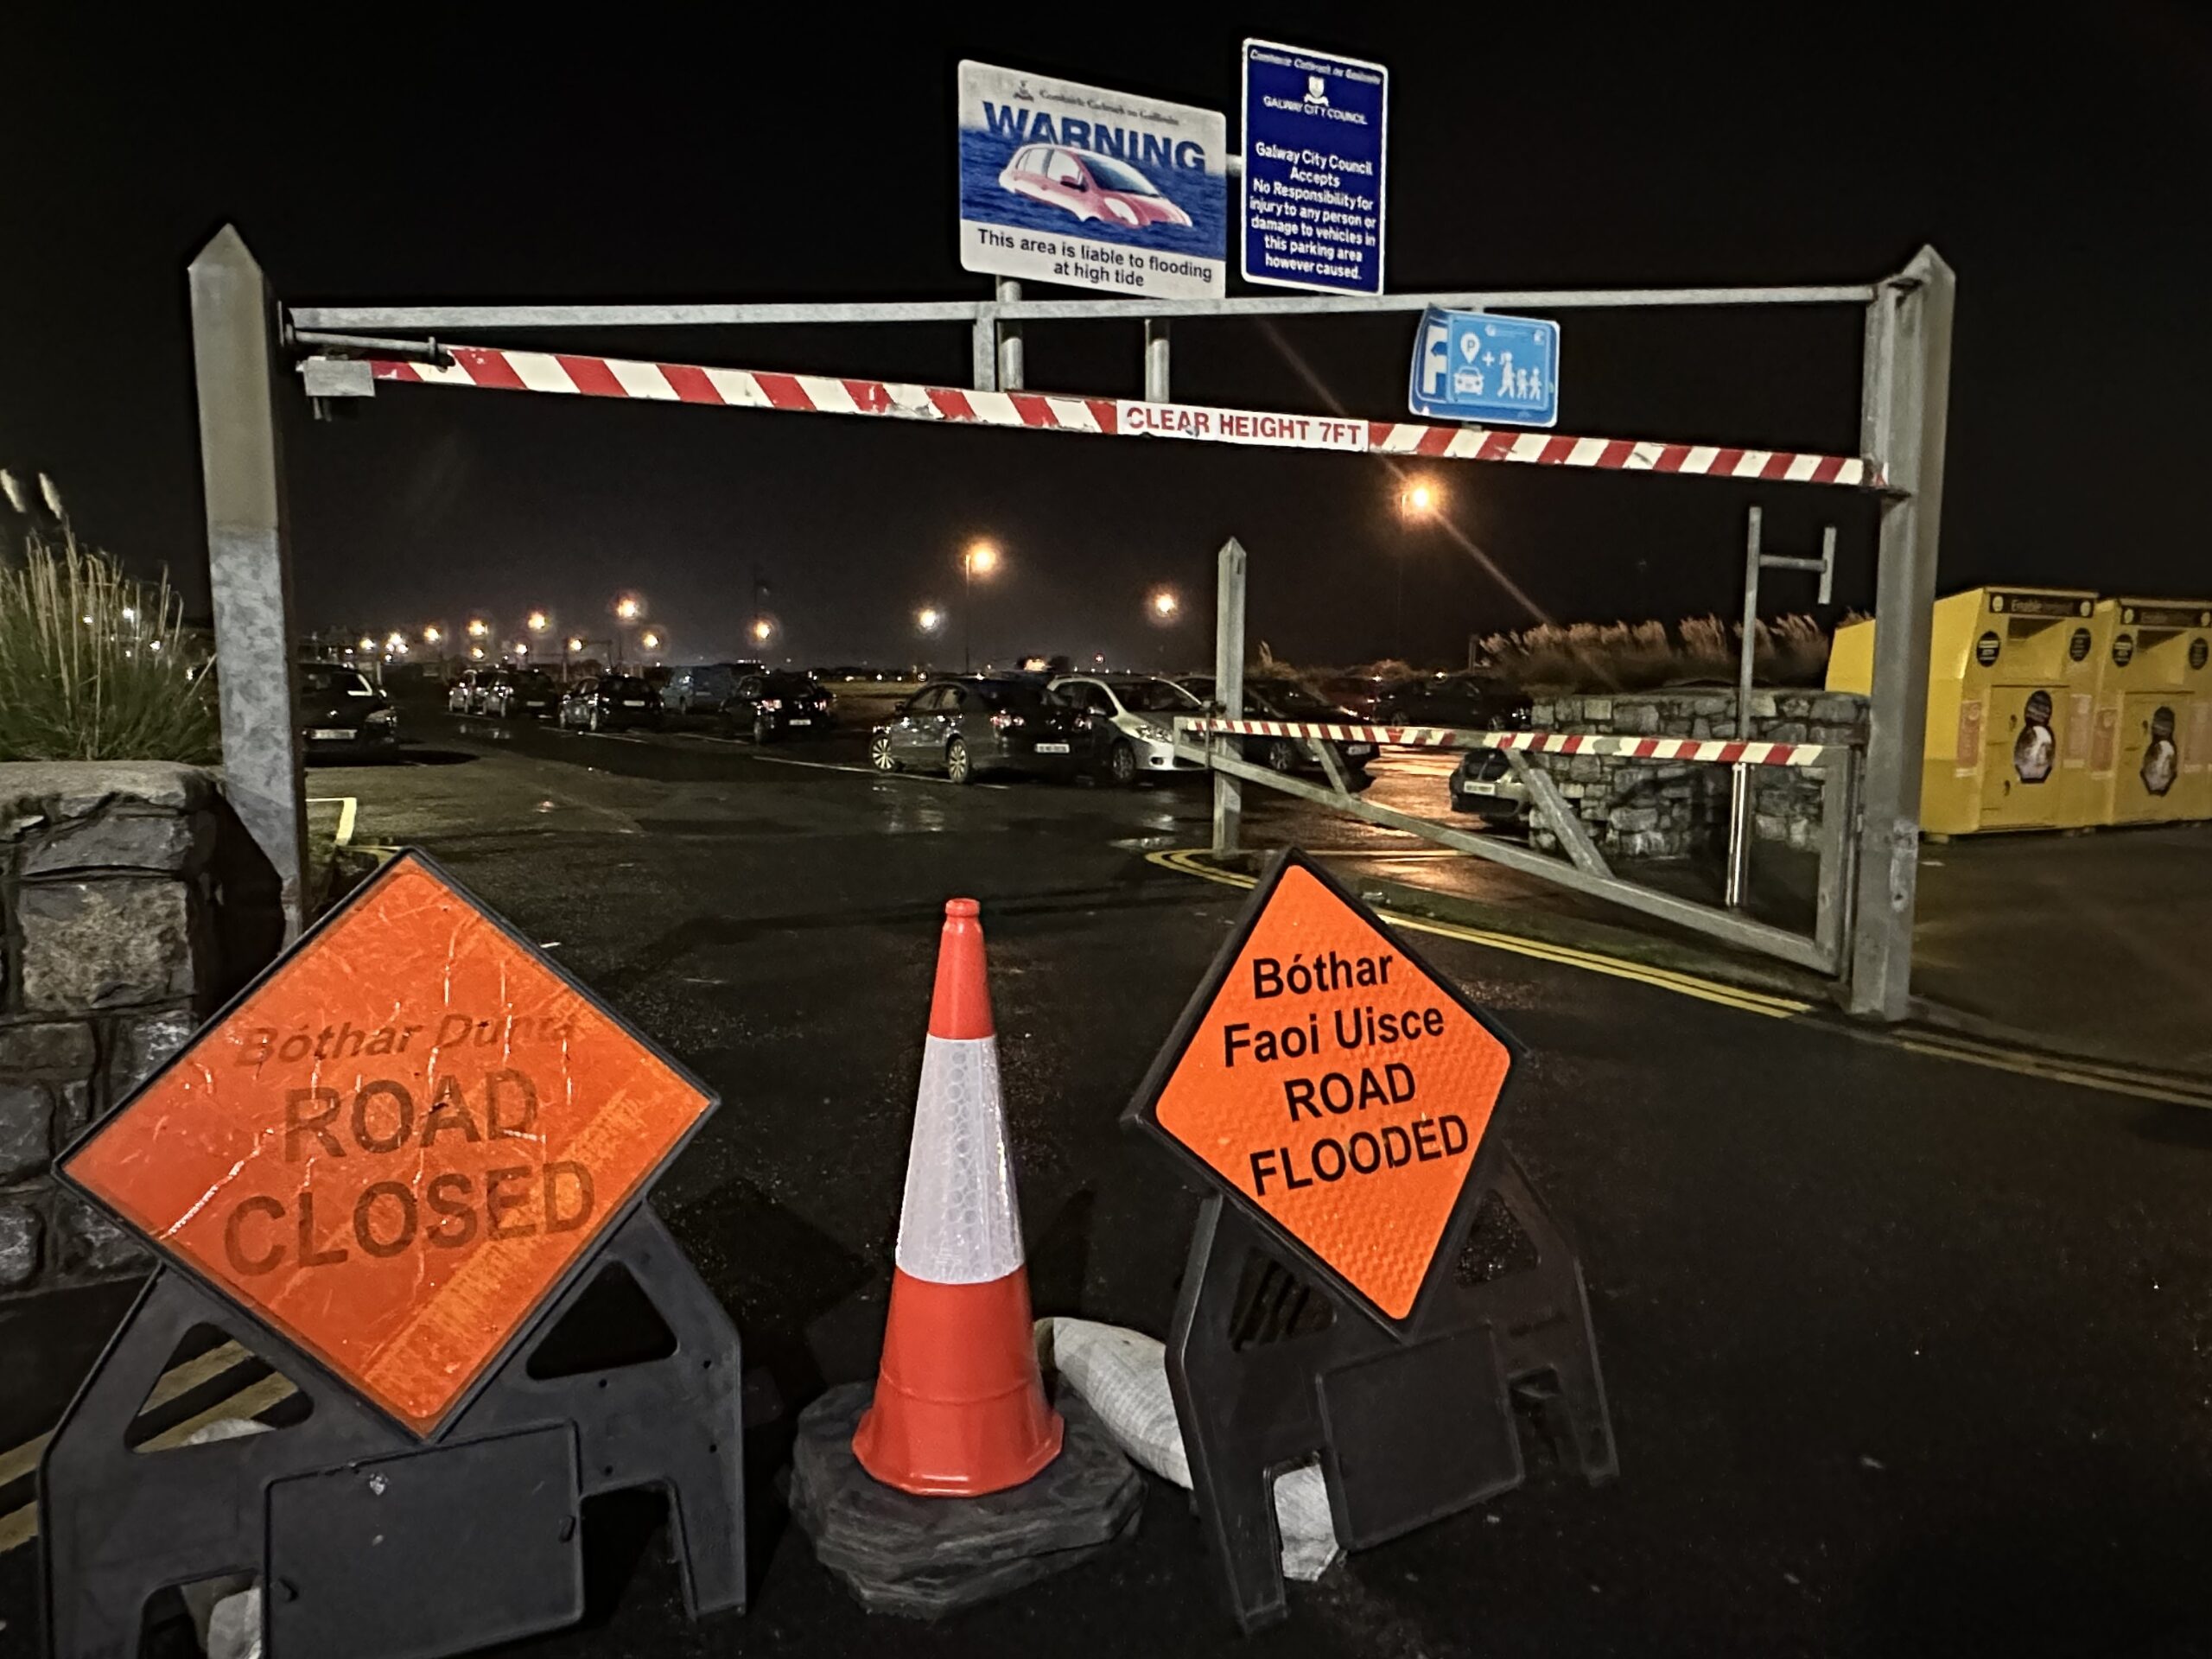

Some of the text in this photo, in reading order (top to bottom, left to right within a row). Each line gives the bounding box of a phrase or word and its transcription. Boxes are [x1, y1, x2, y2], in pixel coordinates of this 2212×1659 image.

[1263, 96, 1368, 125] GALWAY CITY COUNCIL
[982, 100, 1206, 174] WARNING
[1255, 142, 1373, 175] Galway City Council
[1253, 178, 1374, 211] No Responsibility for
[1290, 167, 1340, 188] Accepts
[1249, 196, 1376, 228] injury to any person or
[1250, 214, 1376, 246] damage to vehicles in
[977, 229, 1212, 283] This area is liable to flooding
[1264, 233, 1363, 262] this parking area
[1265, 252, 1362, 280] however caused.
[1053, 260, 1144, 287] at high tide
[1126, 407, 1362, 444] CLEAR HEIGHT 7FT
[1252, 950, 1393, 1000] Bóthar
[233, 1021, 423, 1068] Bóthar
[1223, 1006, 1444, 1068] Faoi Uisce
[1284, 1062, 1416, 1122] ROAD
[284, 1070, 537, 1162] ROAD
[1249, 1114, 1469, 1197] FLOODED
[223, 1160, 595, 1276] CLOSED
